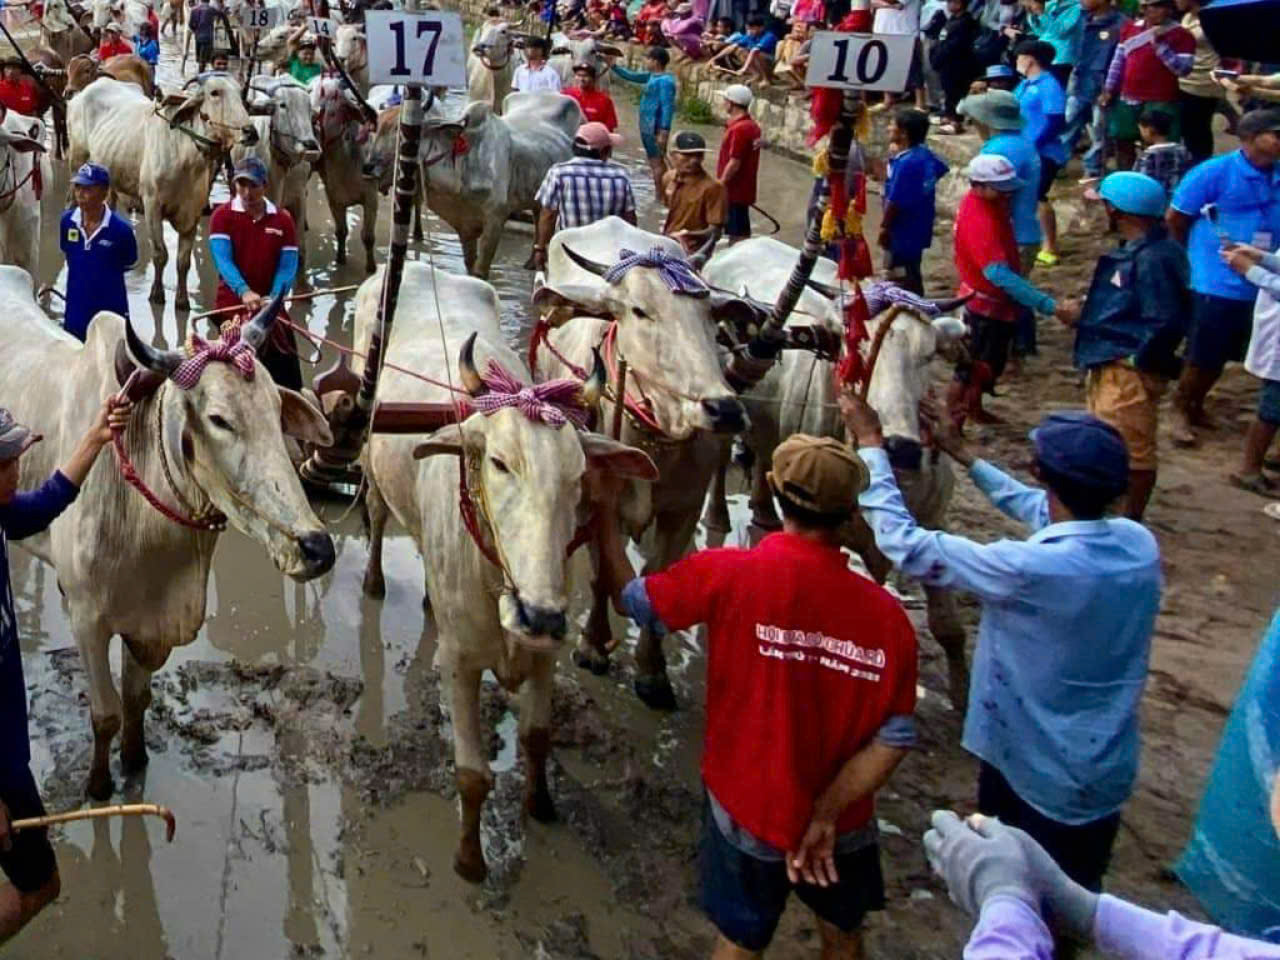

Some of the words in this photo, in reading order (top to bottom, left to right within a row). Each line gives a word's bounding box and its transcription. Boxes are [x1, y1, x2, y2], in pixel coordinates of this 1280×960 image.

[250, 9, 269, 26] 18
[313, 20, 330, 36] 14
[389, 20, 442, 77] 17
[827, 39, 888, 84] 10
